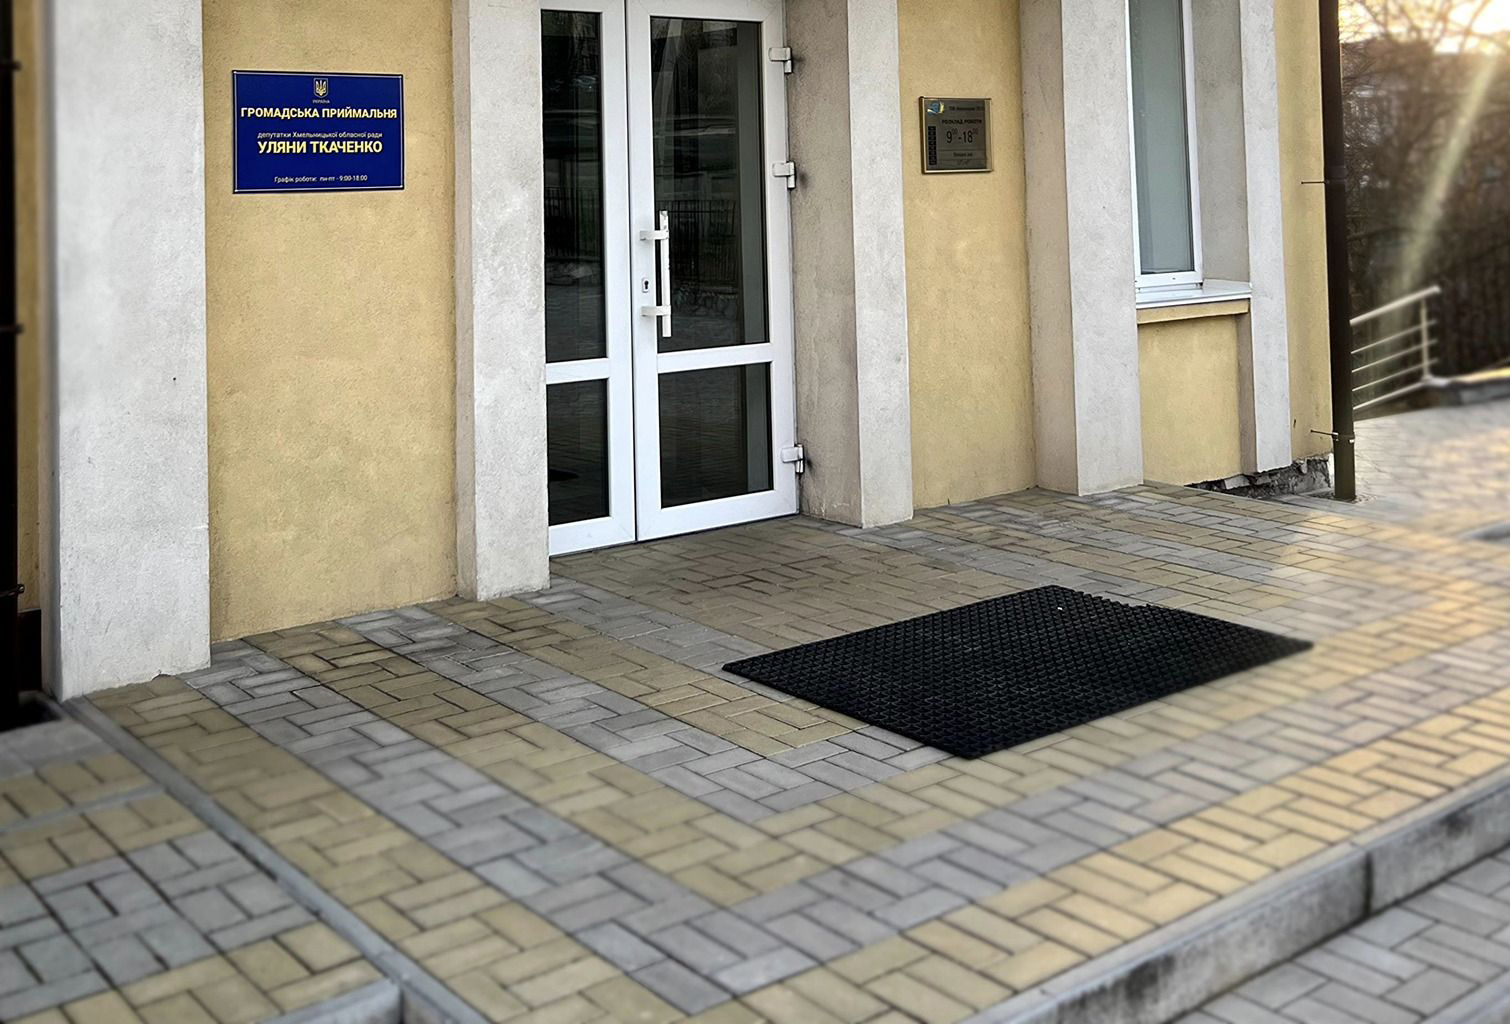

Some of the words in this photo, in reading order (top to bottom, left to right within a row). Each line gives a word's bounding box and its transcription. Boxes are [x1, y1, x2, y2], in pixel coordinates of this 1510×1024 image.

[240, 107, 320, 120] ГРОМАДСЬКА
[322, 106, 398, 119] ПРИЙМАЛЬНЯ
[292, 131, 338, 139] Хмельницької
[257, 141, 307, 154] УЛЯНИ
[309, 141, 383, 153] ТКАЧЕНКО
